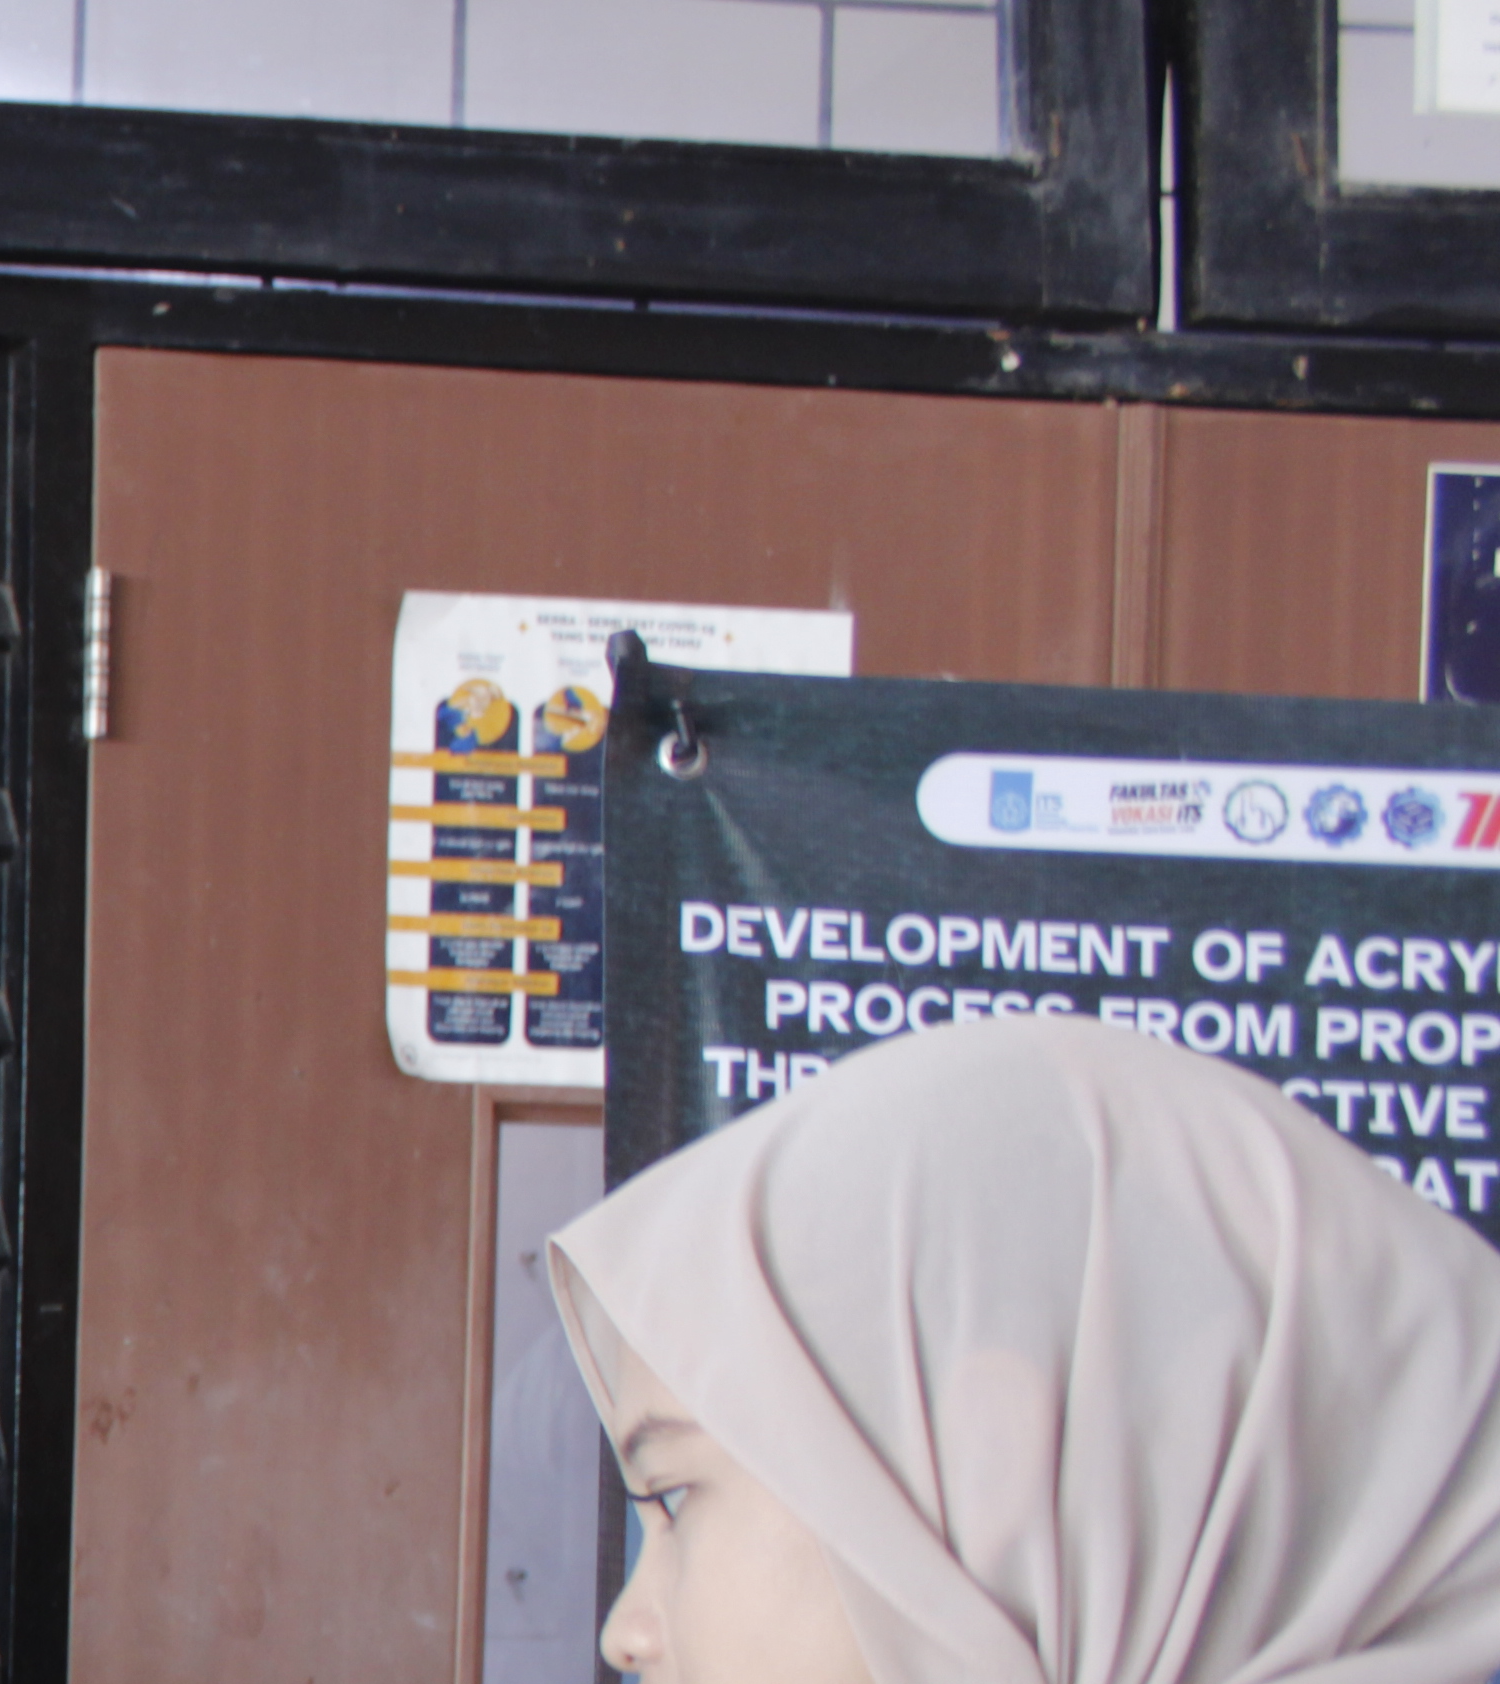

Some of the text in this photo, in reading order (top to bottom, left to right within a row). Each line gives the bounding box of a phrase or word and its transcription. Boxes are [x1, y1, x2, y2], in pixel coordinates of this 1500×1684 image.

[680, 902, 1500, 994] DEVELOPMENT OF ACRY
[1100, 996, 1293, 1058] FROM
[1316, 1005, 1500, 1067] PROP
[1371, 1155, 1500, 1213] AT
